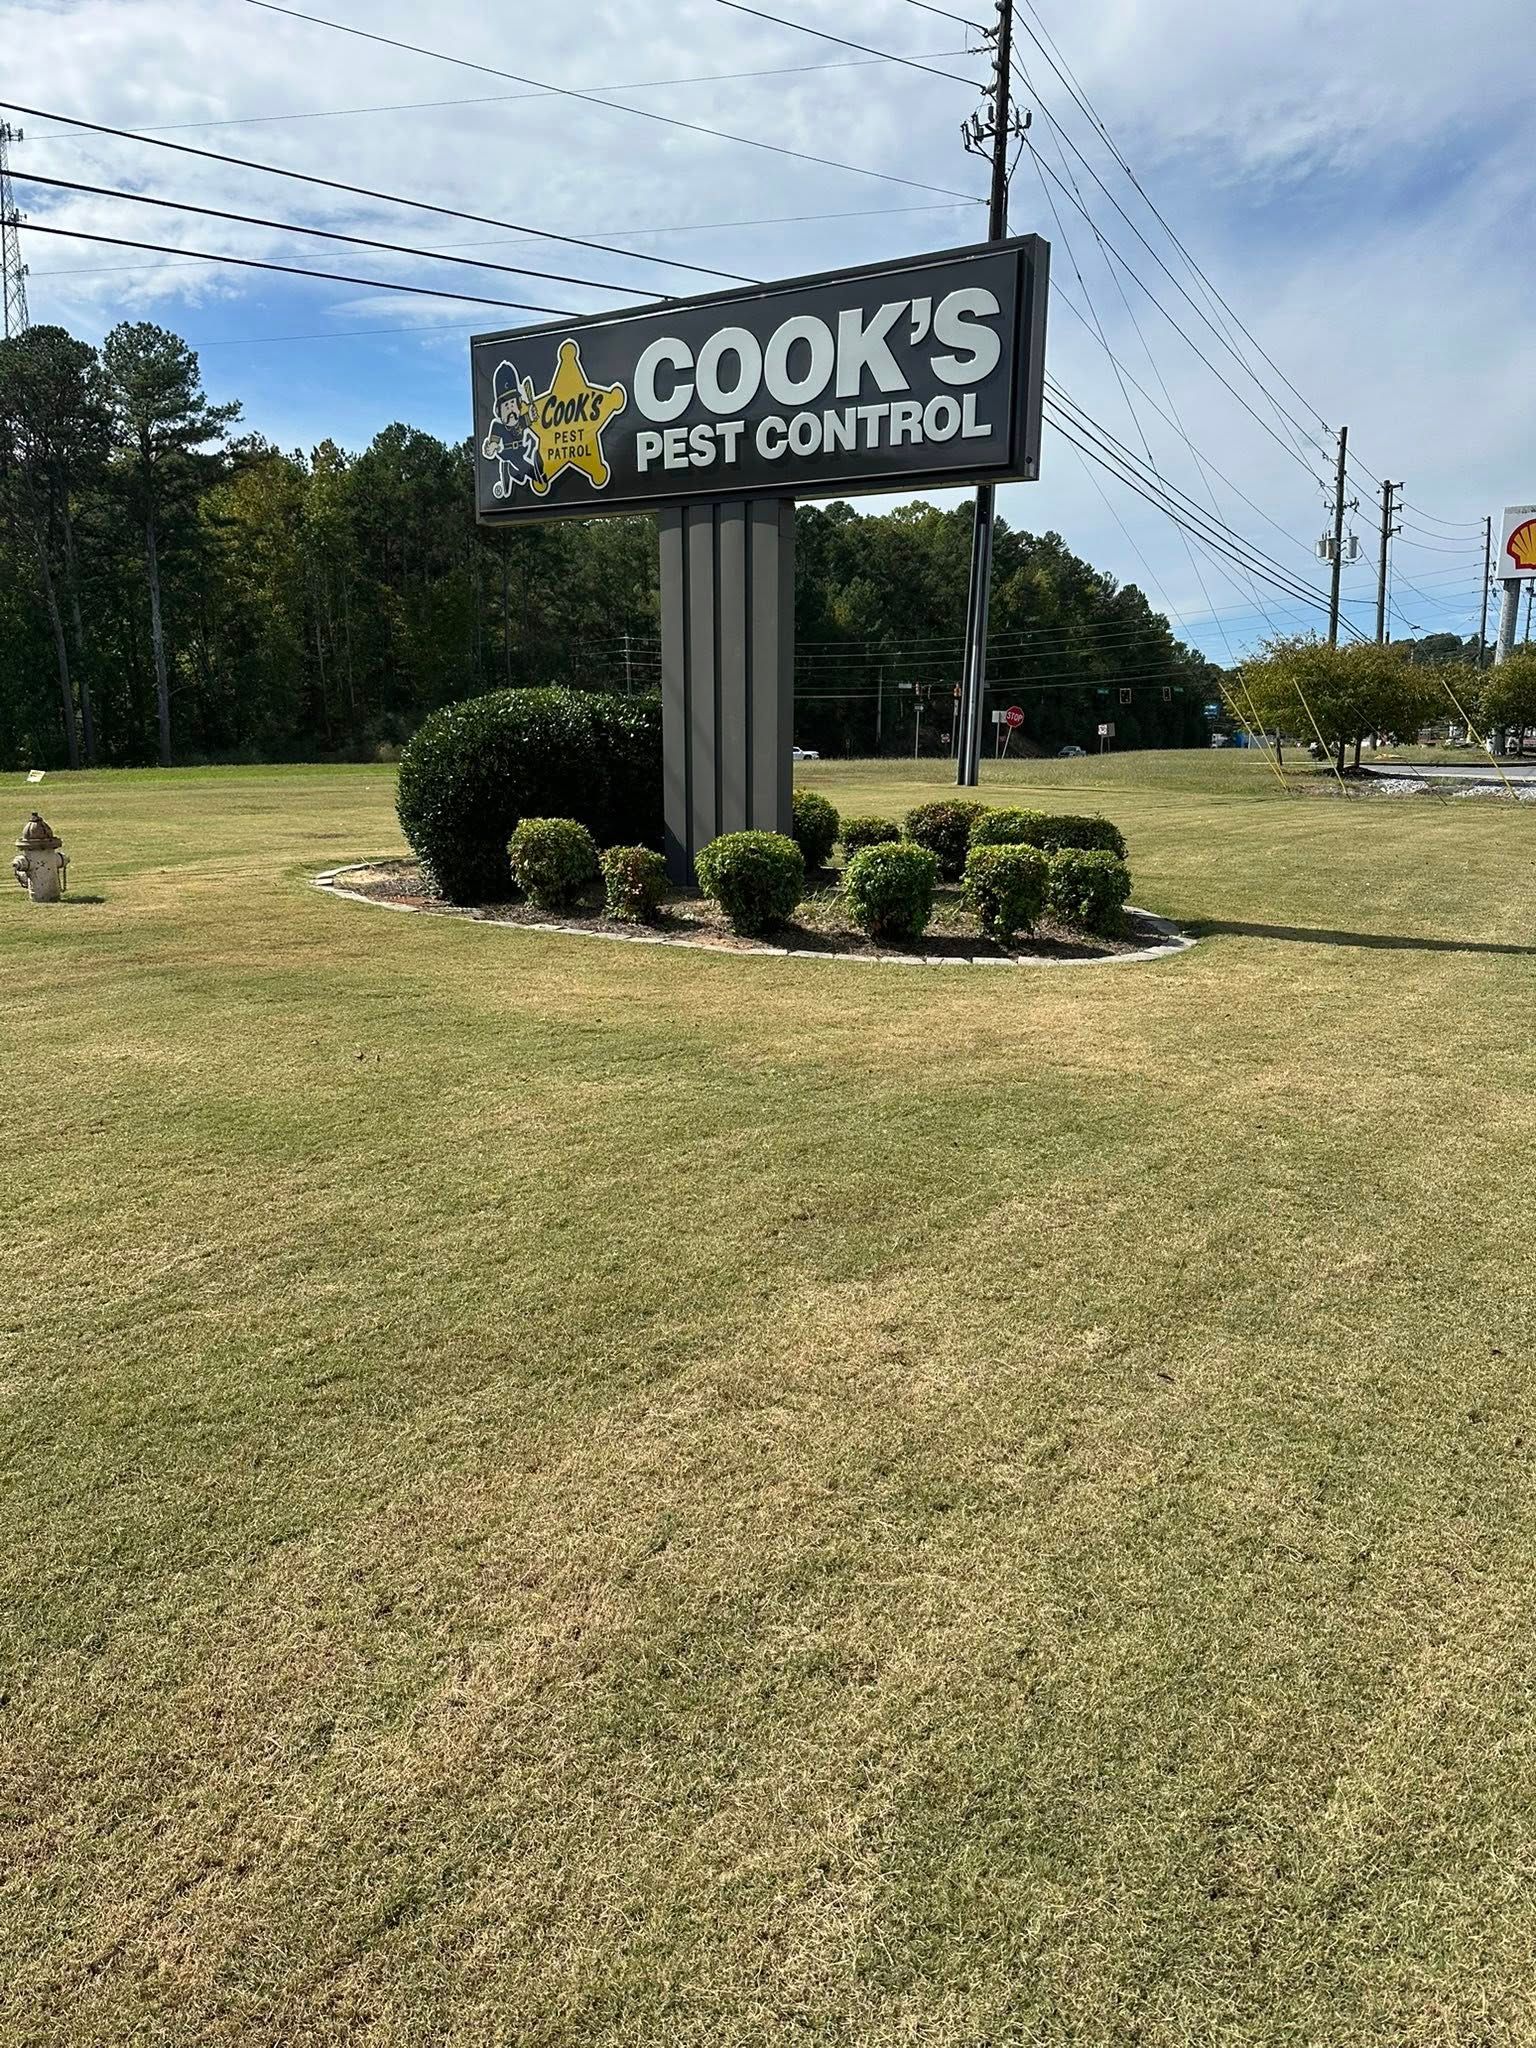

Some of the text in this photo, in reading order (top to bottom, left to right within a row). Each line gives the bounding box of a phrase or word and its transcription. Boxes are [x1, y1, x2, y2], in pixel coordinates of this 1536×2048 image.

[633, 287, 1001, 421] COOK'S
[554, 429, 584, 444] PEST
[637, 393, 991, 472] PEST CONTROL
[548, 445, 591, 460] PATROL
[1007, 712, 1023, 721] STOP
